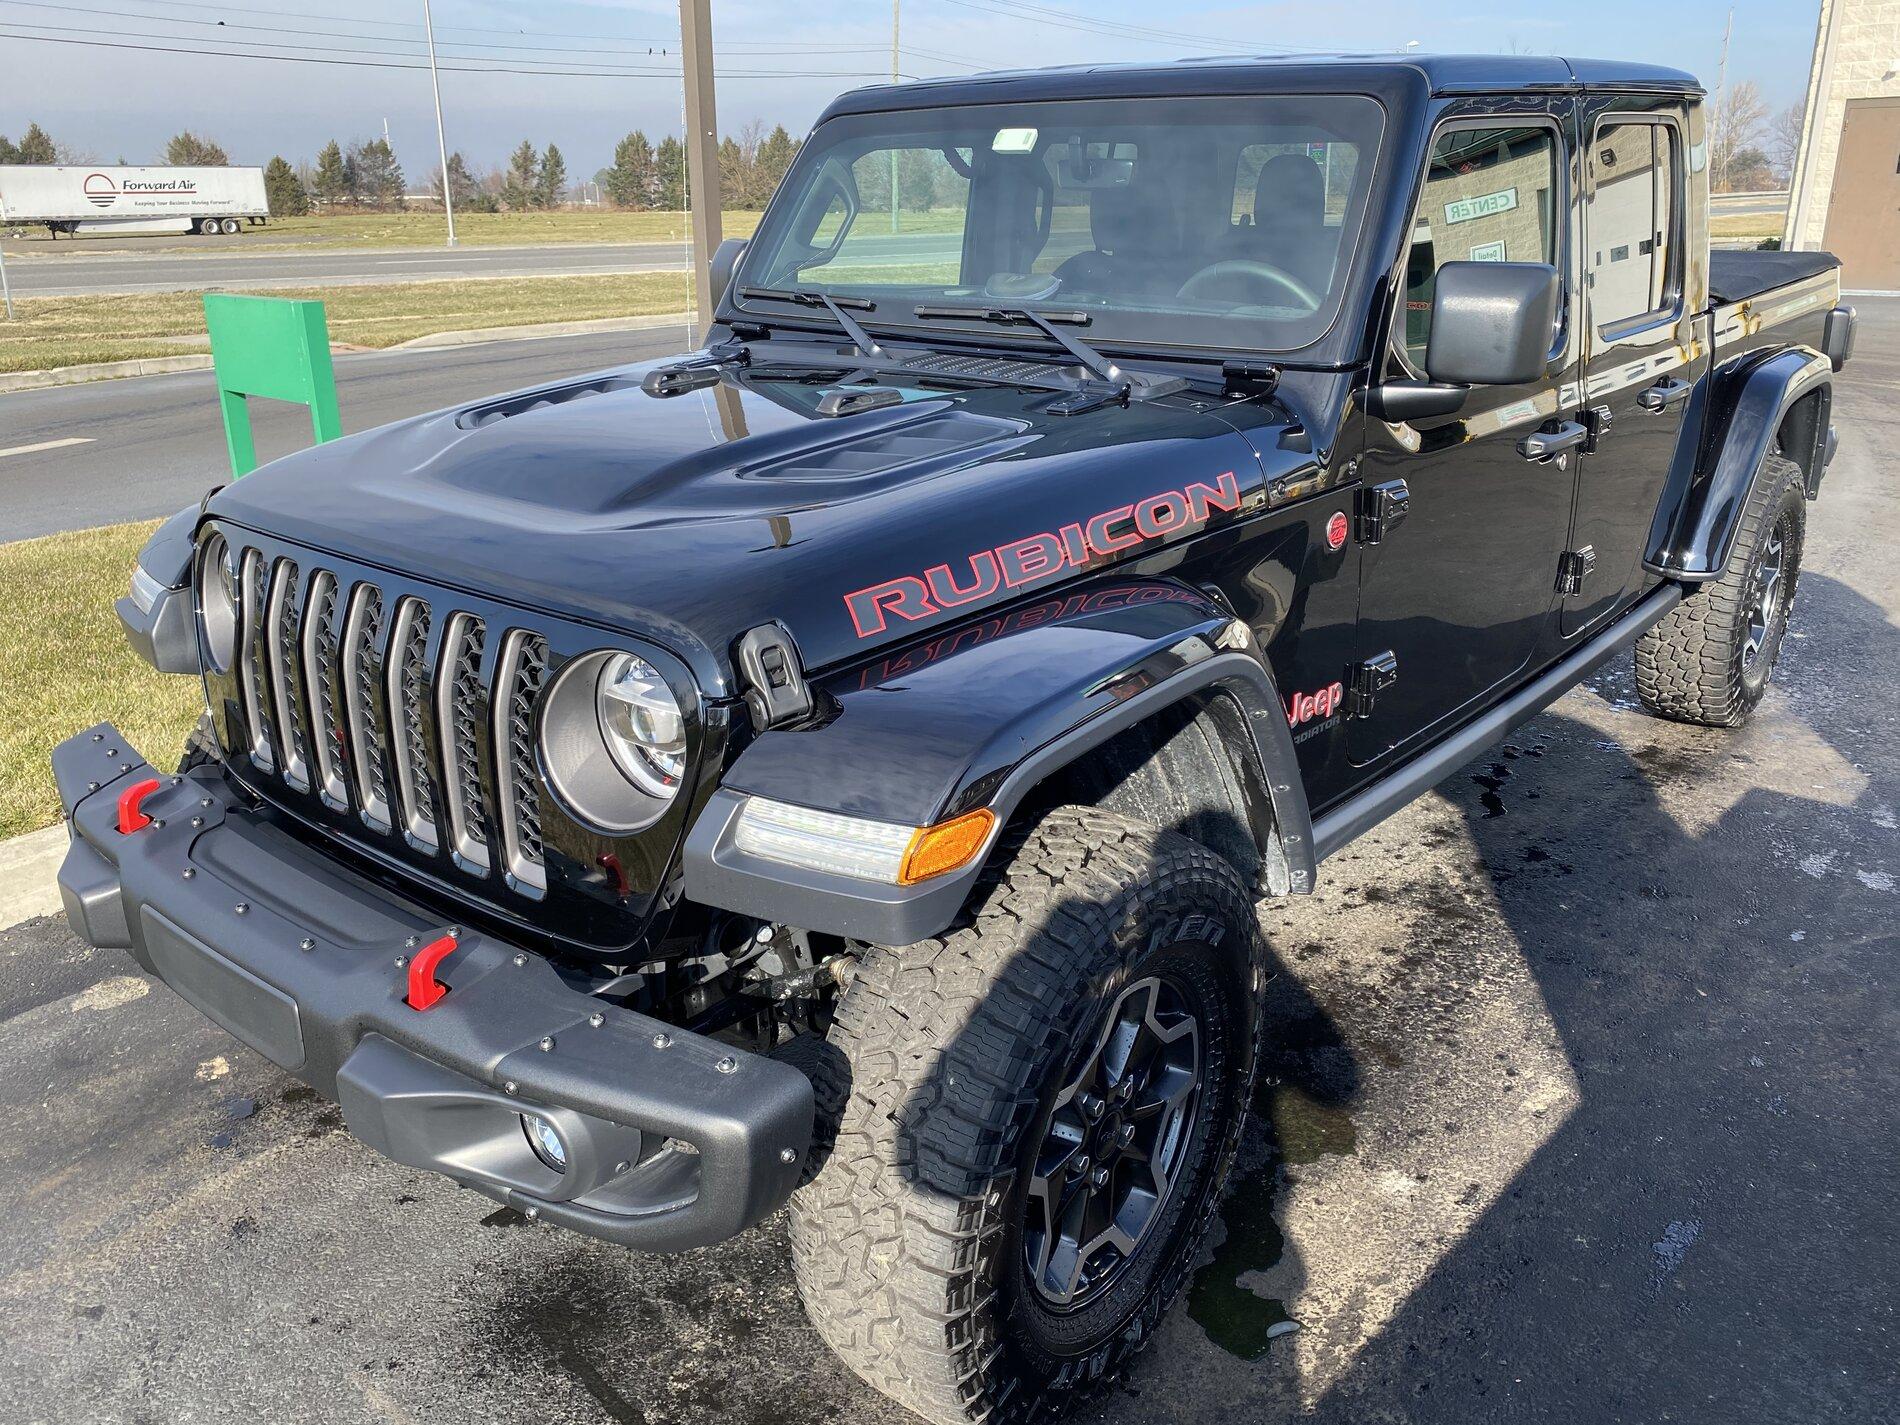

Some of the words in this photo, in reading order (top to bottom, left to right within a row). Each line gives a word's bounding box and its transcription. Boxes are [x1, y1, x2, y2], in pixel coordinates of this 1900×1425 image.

[123, 180, 175, 191] Forward
[178, 180, 196, 190] Air
[843, 471, 1242, 638] RUBICON
[1287, 681, 1343, 729] Jeep
